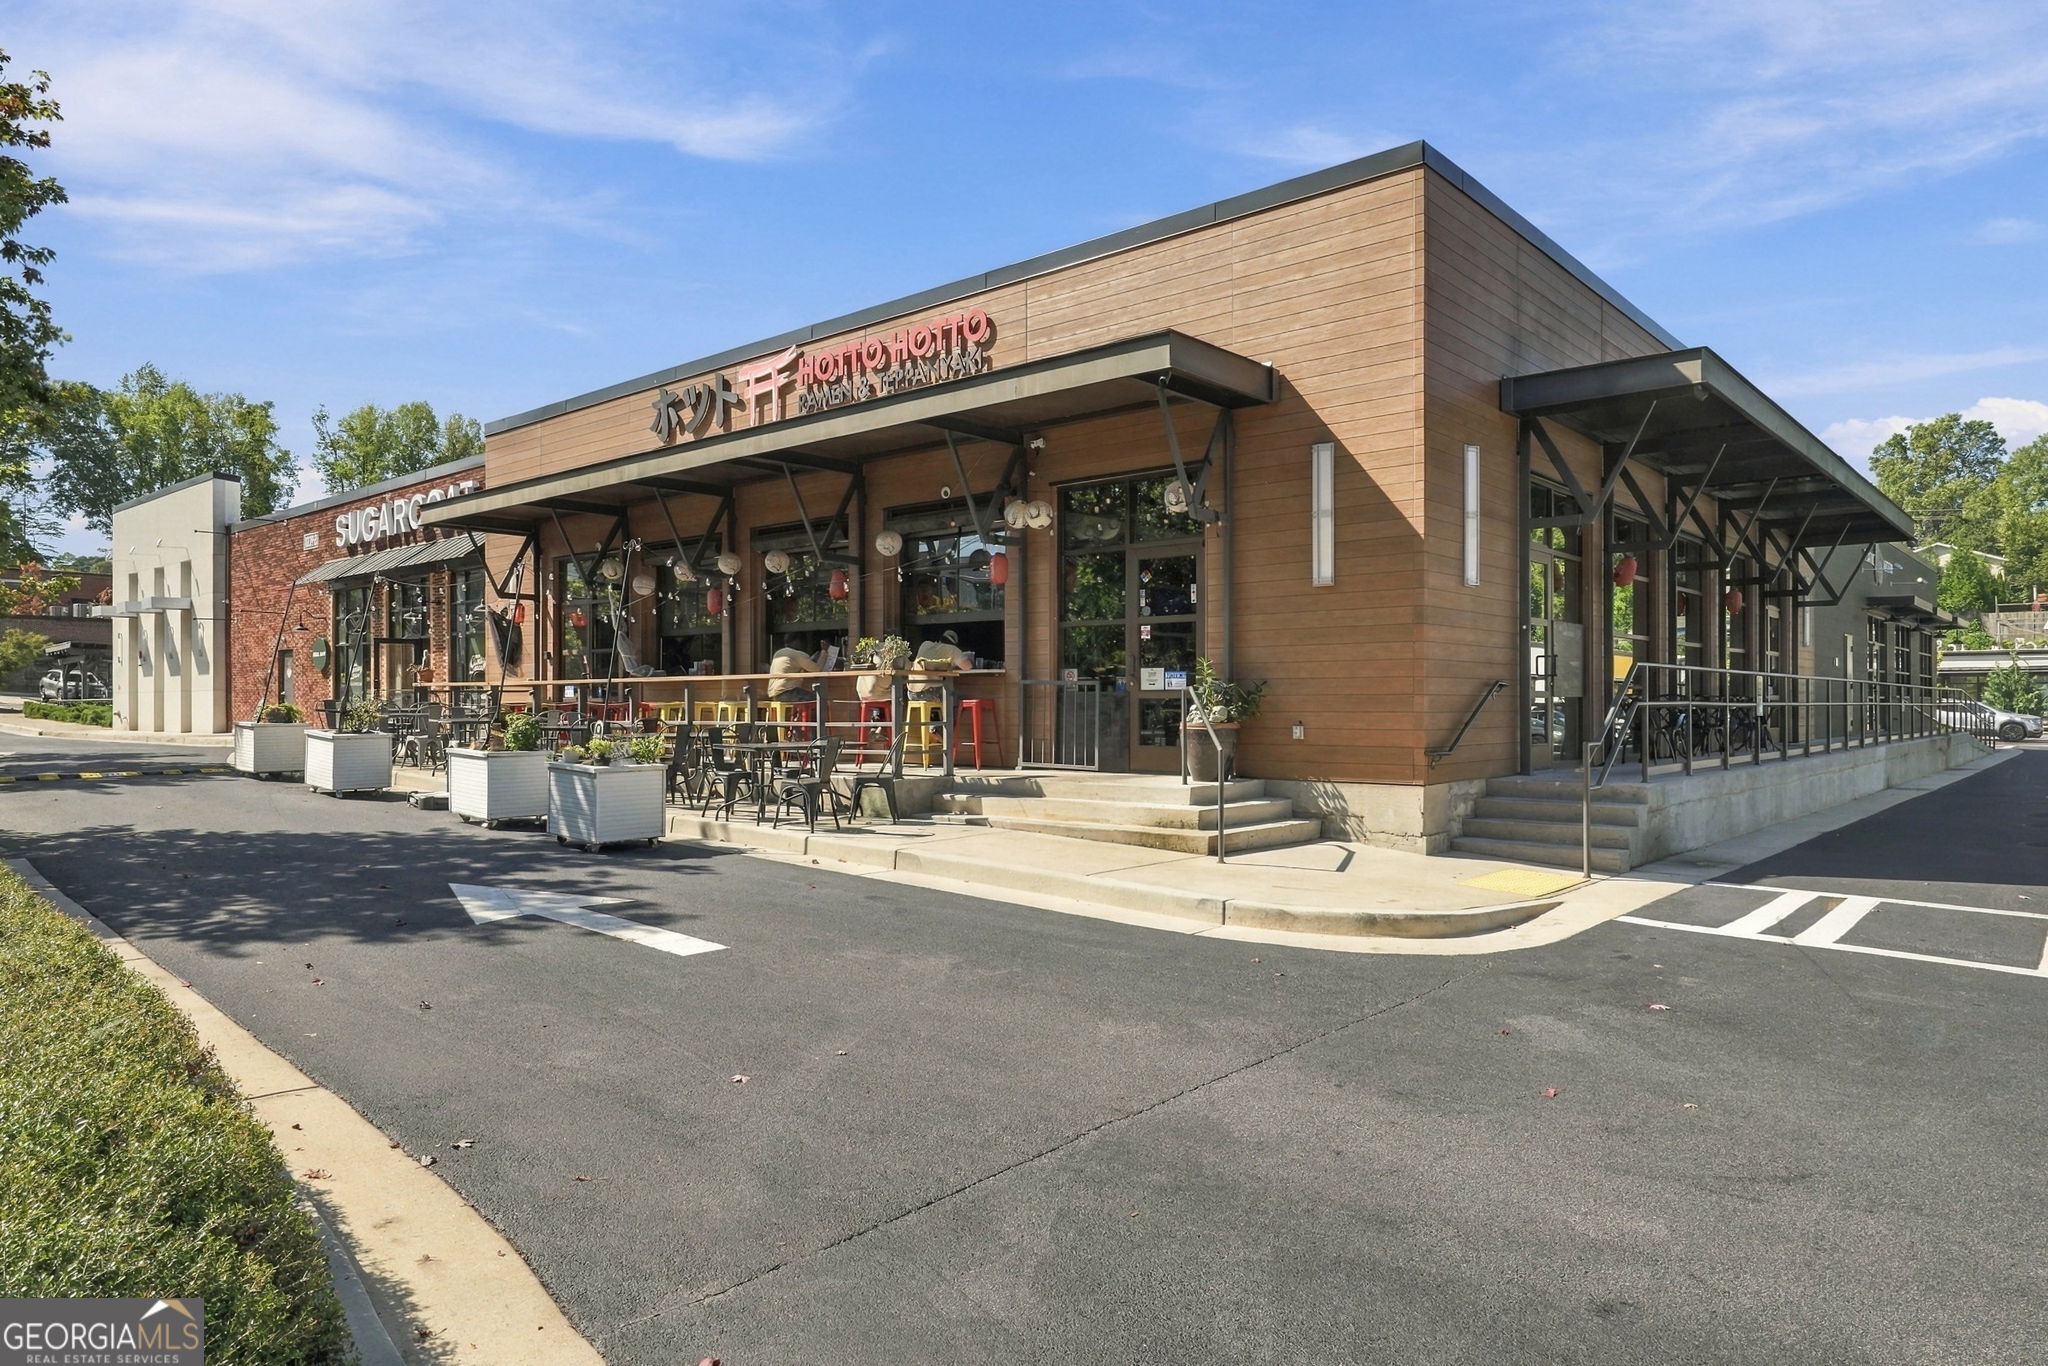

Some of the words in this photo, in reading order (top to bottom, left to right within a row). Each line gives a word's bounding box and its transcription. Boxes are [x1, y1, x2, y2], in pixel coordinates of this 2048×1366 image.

[798, 337, 883, 386] HOTTO
[888, 309, 988, 362] HOTTO
[800, 381, 853, 415] RAMEN
[858, 376, 871, 399] &
[878, 347, 983, 394] TEPPANYAKI
